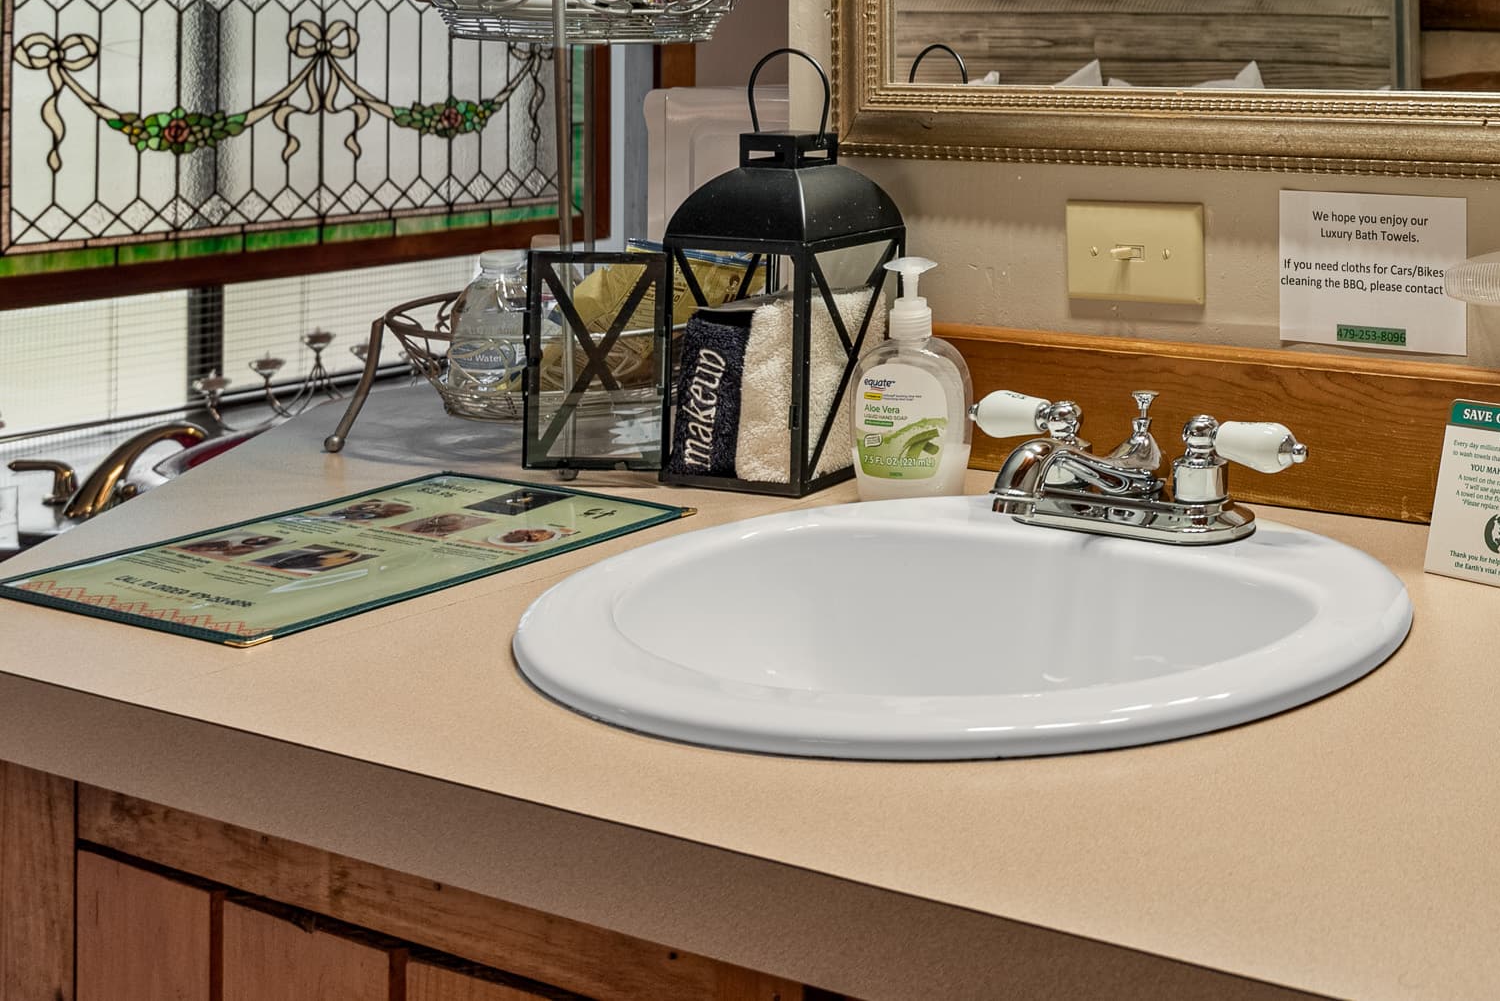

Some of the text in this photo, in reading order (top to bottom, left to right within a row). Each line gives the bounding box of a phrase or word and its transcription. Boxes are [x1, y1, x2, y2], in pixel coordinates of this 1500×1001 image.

[1312, 210, 1429, 227] We hope you enjoy our
[1320, 228, 1420, 243] Luxury Bath Towels.
[1284, 259, 1444, 278] If you need cloths for Cars/Bikes
[1281, 275, 1444, 295] cleaning the BBQ, please contact
[1336, 327, 1406, 343] 479-253-8096
[864, 378, 891, 389] equate
[682, 348, 726, 471] makeup
[864, 403, 900, 414] Aloe Vera
[1463, 408, 1493, 423] SAVE
[1453, 439, 1468, 448] Every
[1469, 442, 1479, 450] day
[1480, 444, 1500, 452] millions
[864, 454, 874, 464] 7.5
[875, 456, 884, 465] FL
[886, 457, 898, 466] OZ
[1471, 463, 1486, 473] YOU
[1487, 477, 1496, 485] the
[1461, 490, 1475, 498] towel
[1450, 550, 1467, 559] Thank
[1479, 555, 1488, 563] for
[1464, 563, 1484, 573] Earth's
[1485, 566, 1497, 575] vital
